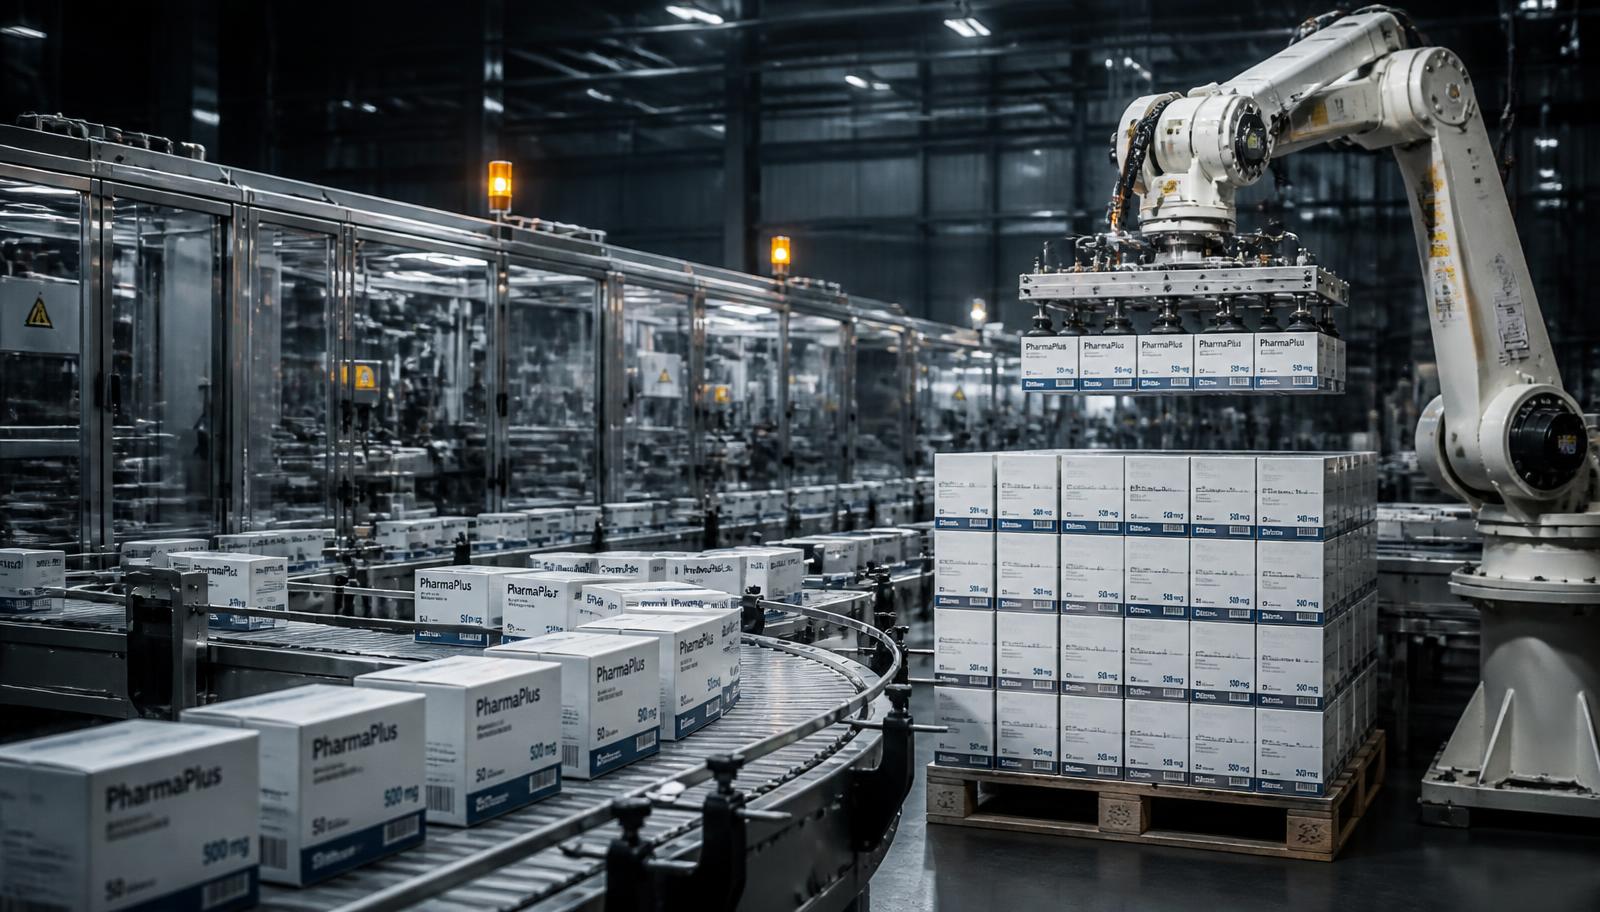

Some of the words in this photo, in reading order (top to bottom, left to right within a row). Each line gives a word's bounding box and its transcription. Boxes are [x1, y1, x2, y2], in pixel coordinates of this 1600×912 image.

[420, 578, 472, 590] PharmaPlus
[596, 656, 645, 683] PharmaPlus
[476, 686, 541, 718] PharmaPlus
[312, 721, 398, 760] PharmaPlus
[104, 765, 223, 813] PharmaPlus
